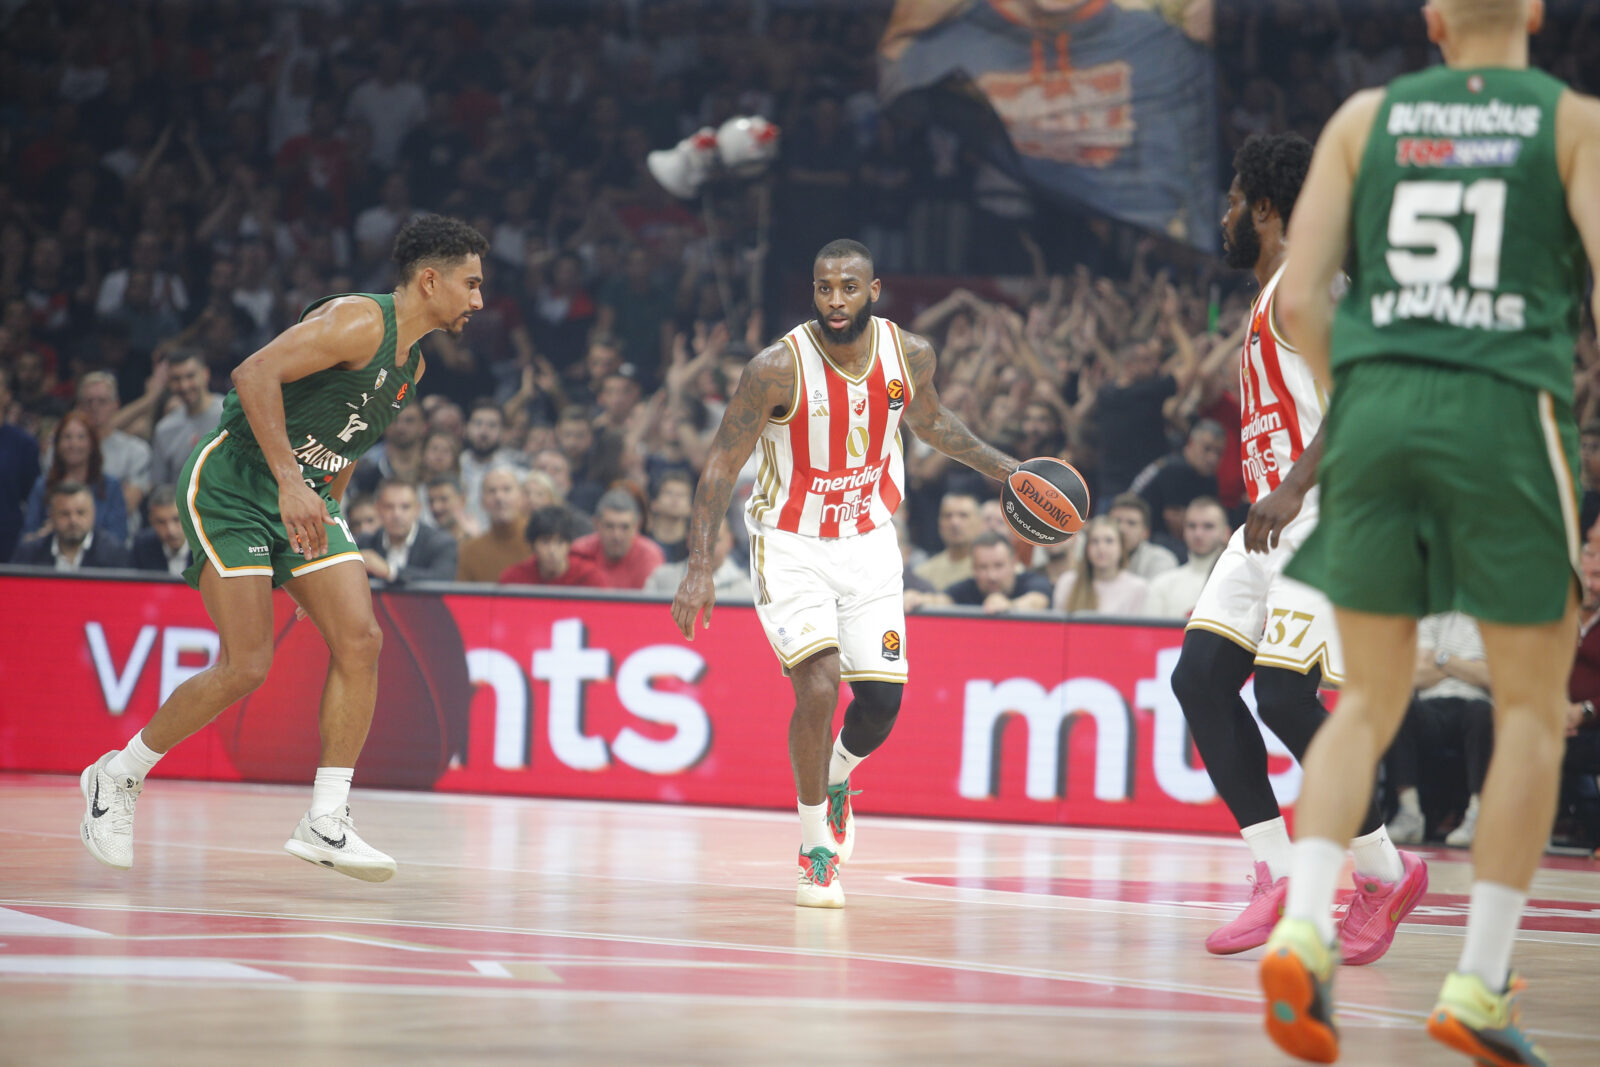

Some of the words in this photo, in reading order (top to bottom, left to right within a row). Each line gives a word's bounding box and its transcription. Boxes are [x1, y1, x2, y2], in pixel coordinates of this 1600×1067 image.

[1386, 178, 1507, 290] 51
[846, 426, 870, 458] 0
[1241, 411, 1282, 443] eridian
[811, 465, 882, 493] meridia
[1242, 446, 1278, 482] mts
[821, 494, 872, 524] mts
[1017, 479, 1072, 528] SPALDING
[1266, 608, 1315, 648] 37
